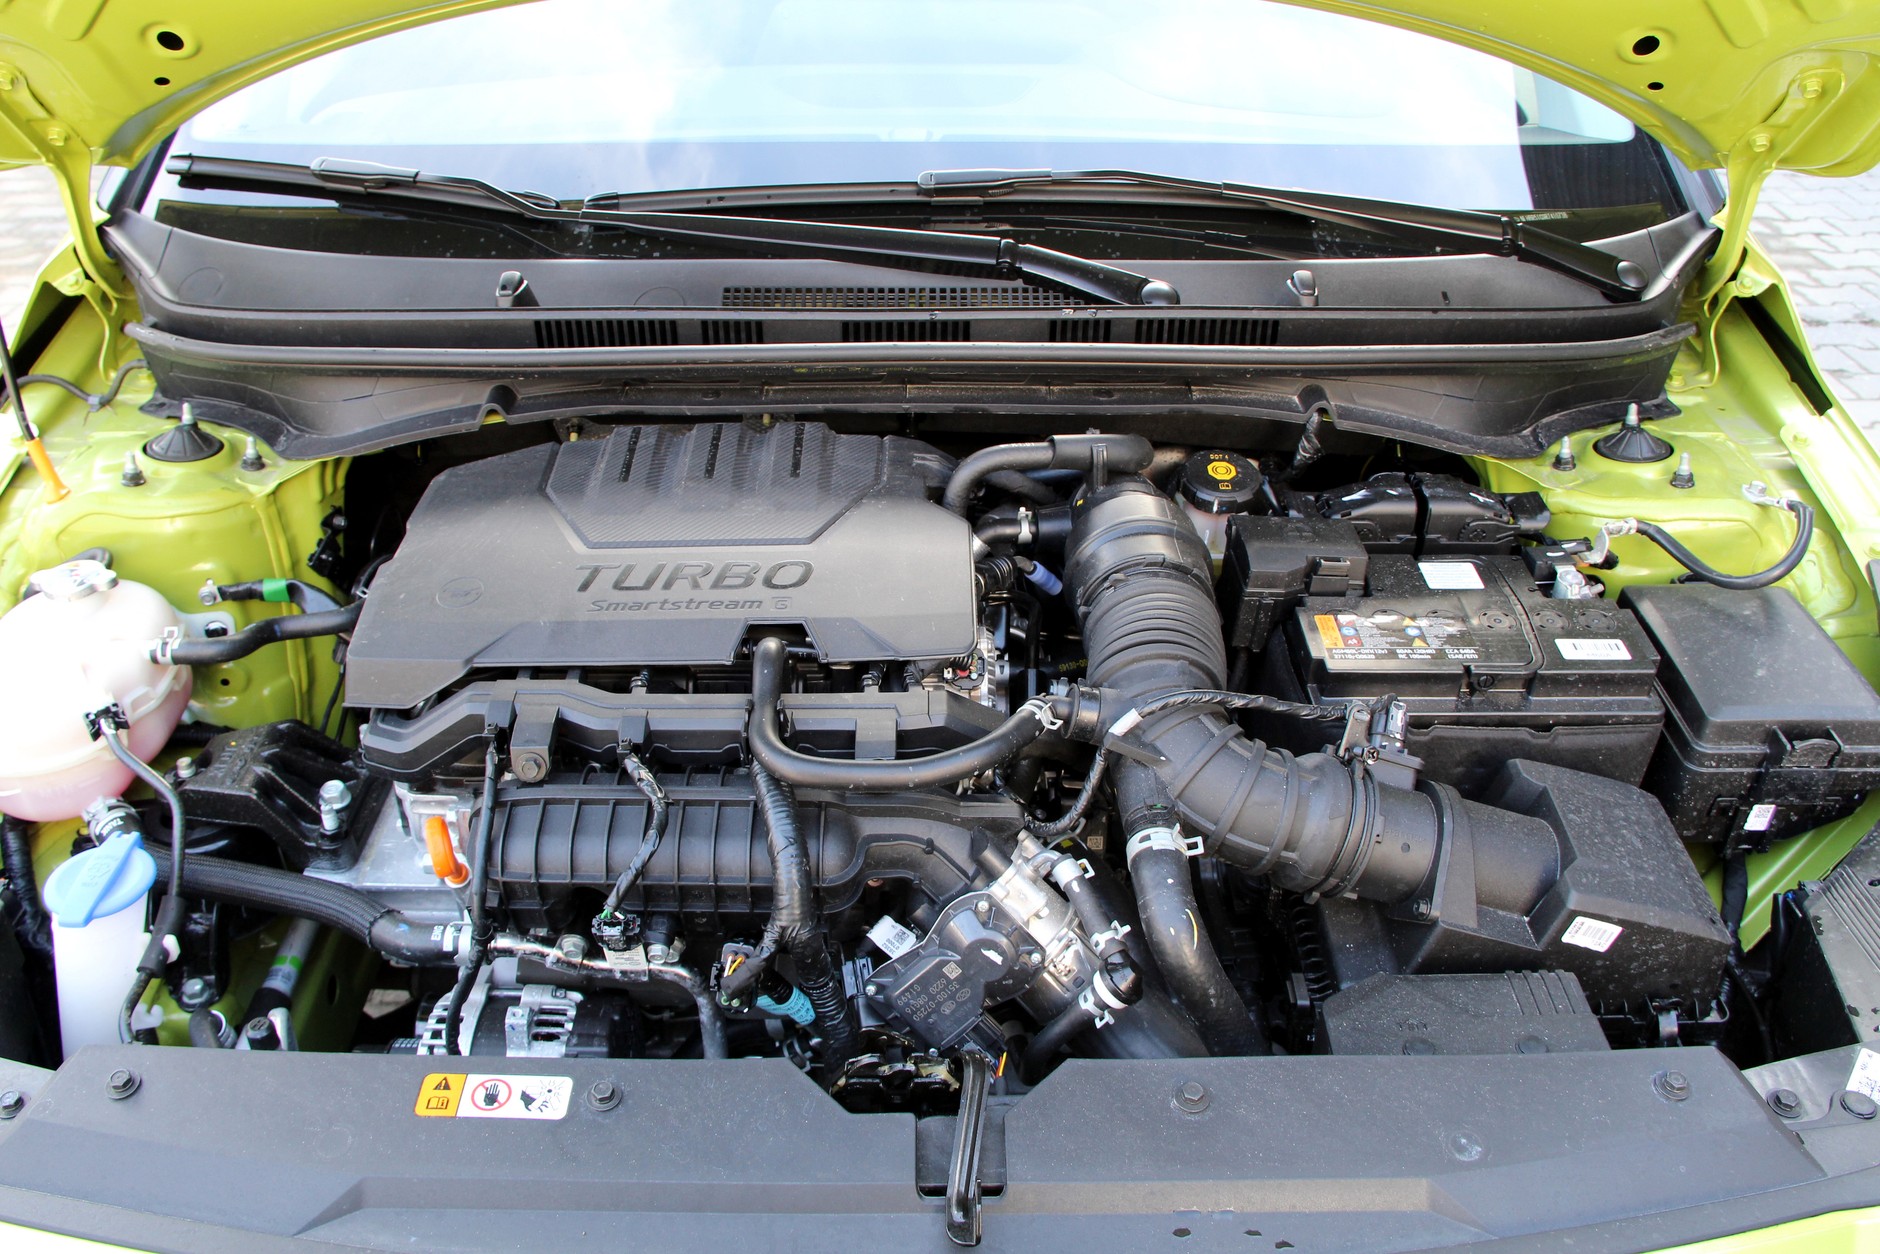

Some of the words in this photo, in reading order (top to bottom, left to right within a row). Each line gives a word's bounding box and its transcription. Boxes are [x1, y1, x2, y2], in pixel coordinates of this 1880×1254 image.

[575, 560, 815, 592] TURBO
[586, 598, 763, 613] Smartstream
[100, 817, 124, 836] TANK
[431, 925, 444, 941] ENG
[929, 978, 947, 995] 6220
[913, 981, 960, 1021] 35100-07250
